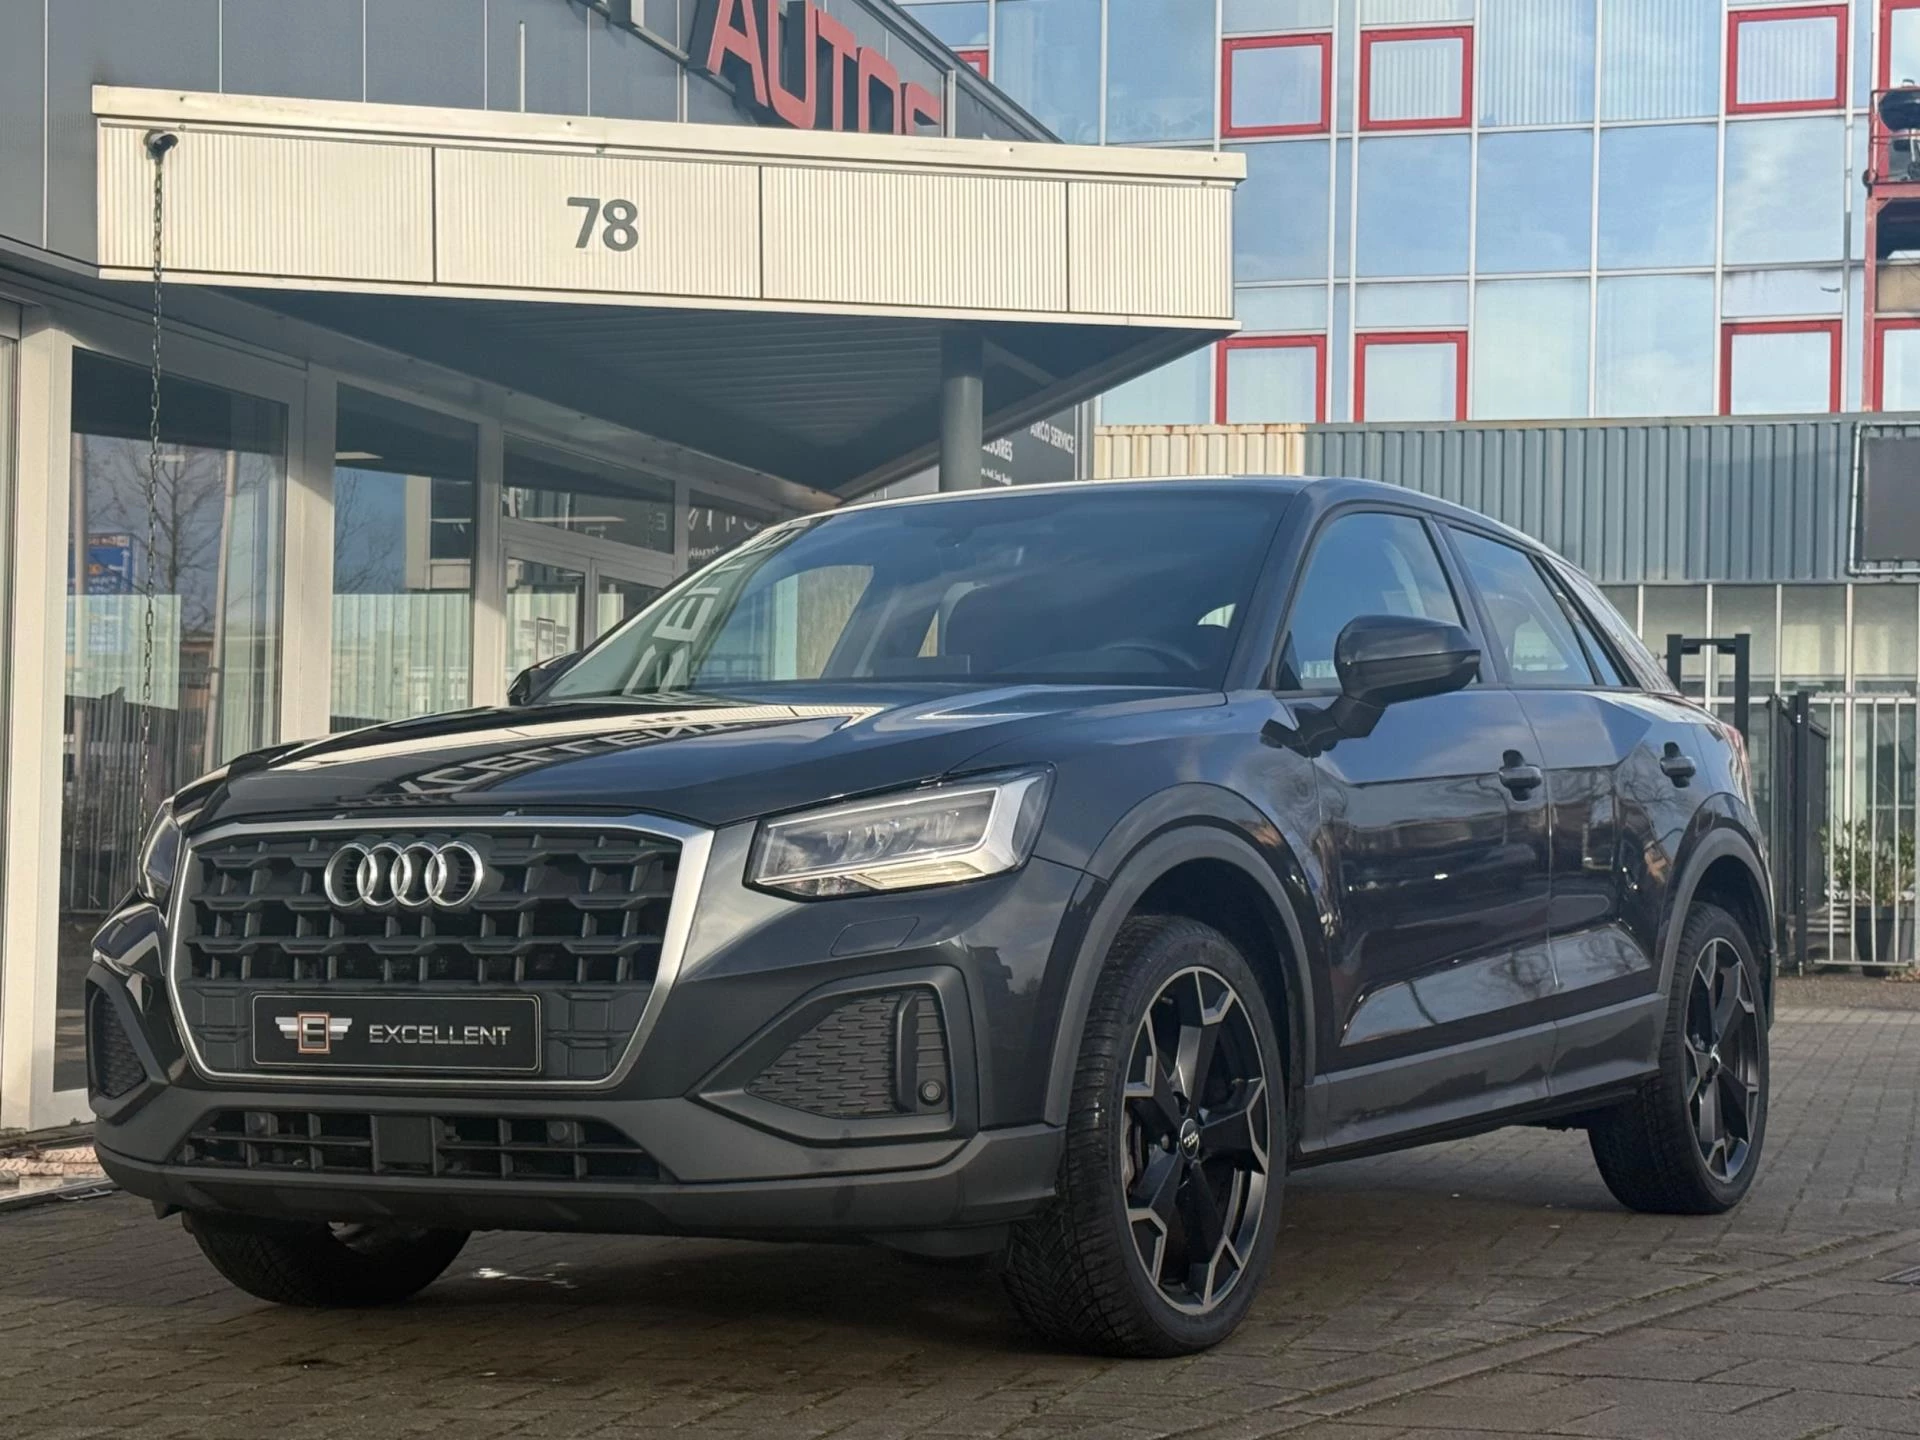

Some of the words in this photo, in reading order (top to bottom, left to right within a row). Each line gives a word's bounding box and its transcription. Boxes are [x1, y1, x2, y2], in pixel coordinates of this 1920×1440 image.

[567, 197, 639, 252] 78
[1050, 425, 1074, 454] SERVICE
[368, 1024, 512, 1046] EXCELLENT
